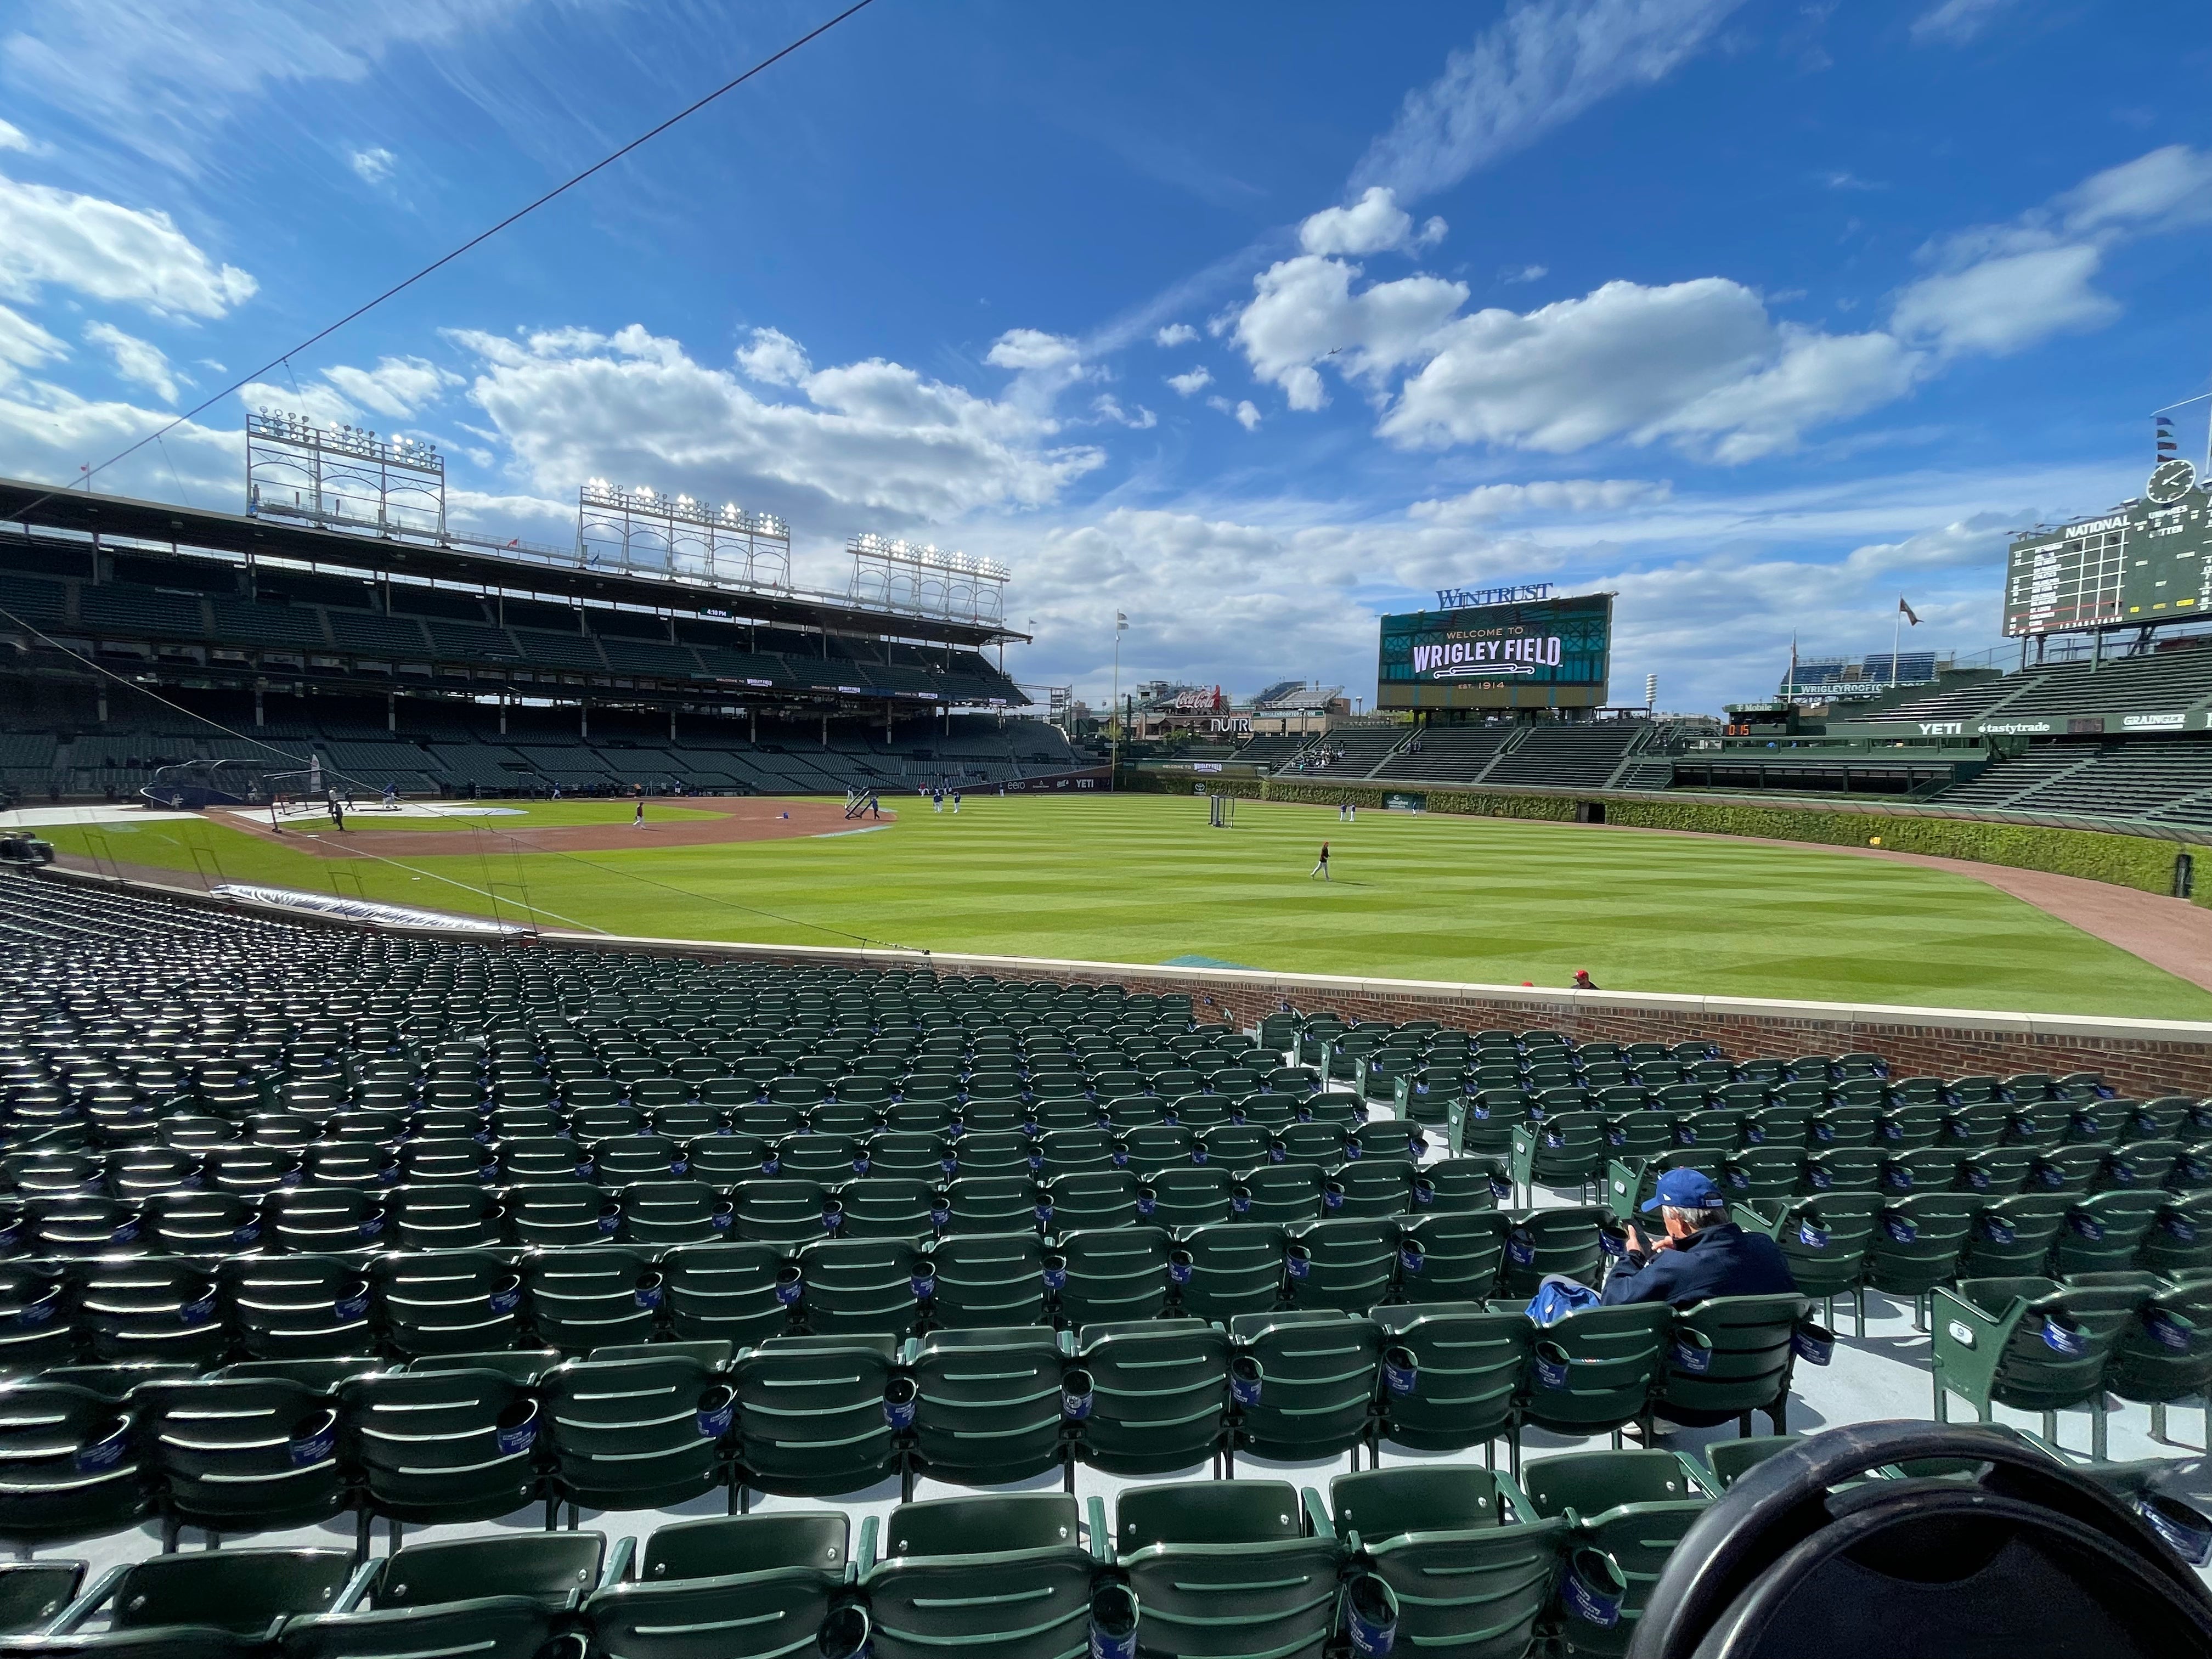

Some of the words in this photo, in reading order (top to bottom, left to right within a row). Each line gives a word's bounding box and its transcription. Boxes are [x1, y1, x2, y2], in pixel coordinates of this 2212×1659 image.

[2065, 515, 2130, 538] NATIONAL
[1436, 583, 1554, 609] WINTRUST
[1447, 628, 1503, 639] WELCOME
[1508, 627, 1523, 635] TO
[1413, 641, 1500, 673] WRIGLEY
[1504, 637, 1561, 666] FIELD
[1919, 723, 1962, 735] YETI
[1987, 722, 2050, 734] tastytrade
[2123, 714, 2186, 725] GRAINGER
[1076, 779, 1094, 788] YETI
[1957, 1328, 1965, 1337] 9
